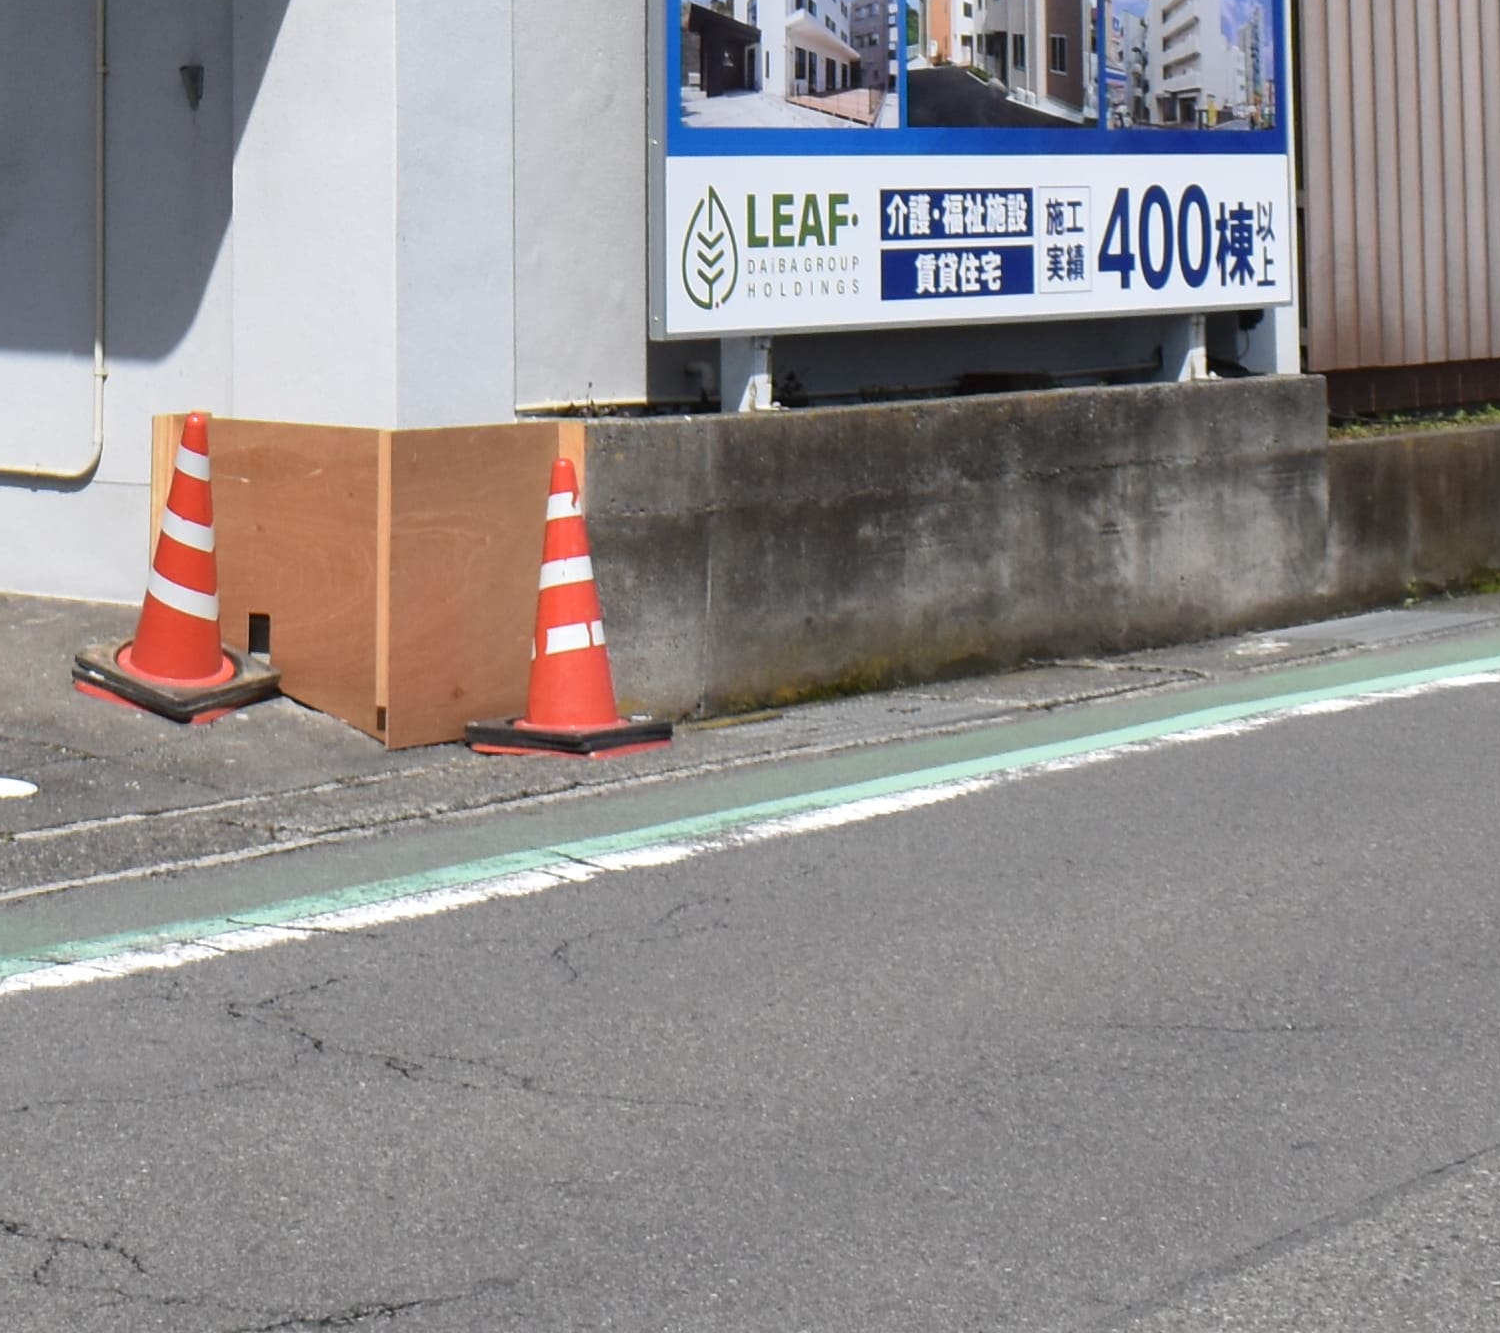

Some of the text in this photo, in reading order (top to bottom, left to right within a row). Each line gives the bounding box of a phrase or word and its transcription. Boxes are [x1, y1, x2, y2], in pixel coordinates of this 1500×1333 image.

[886, 193, 1028, 236] 介護・福祉施設
[1045, 197, 1085, 236] 施工
[804, 255, 860, 273] GROUP
[915, 251, 1002, 294] 賃貸住宅
[1046, 244, 1085, 282] 実績
[747, 279, 860, 299] HOLDINGS
